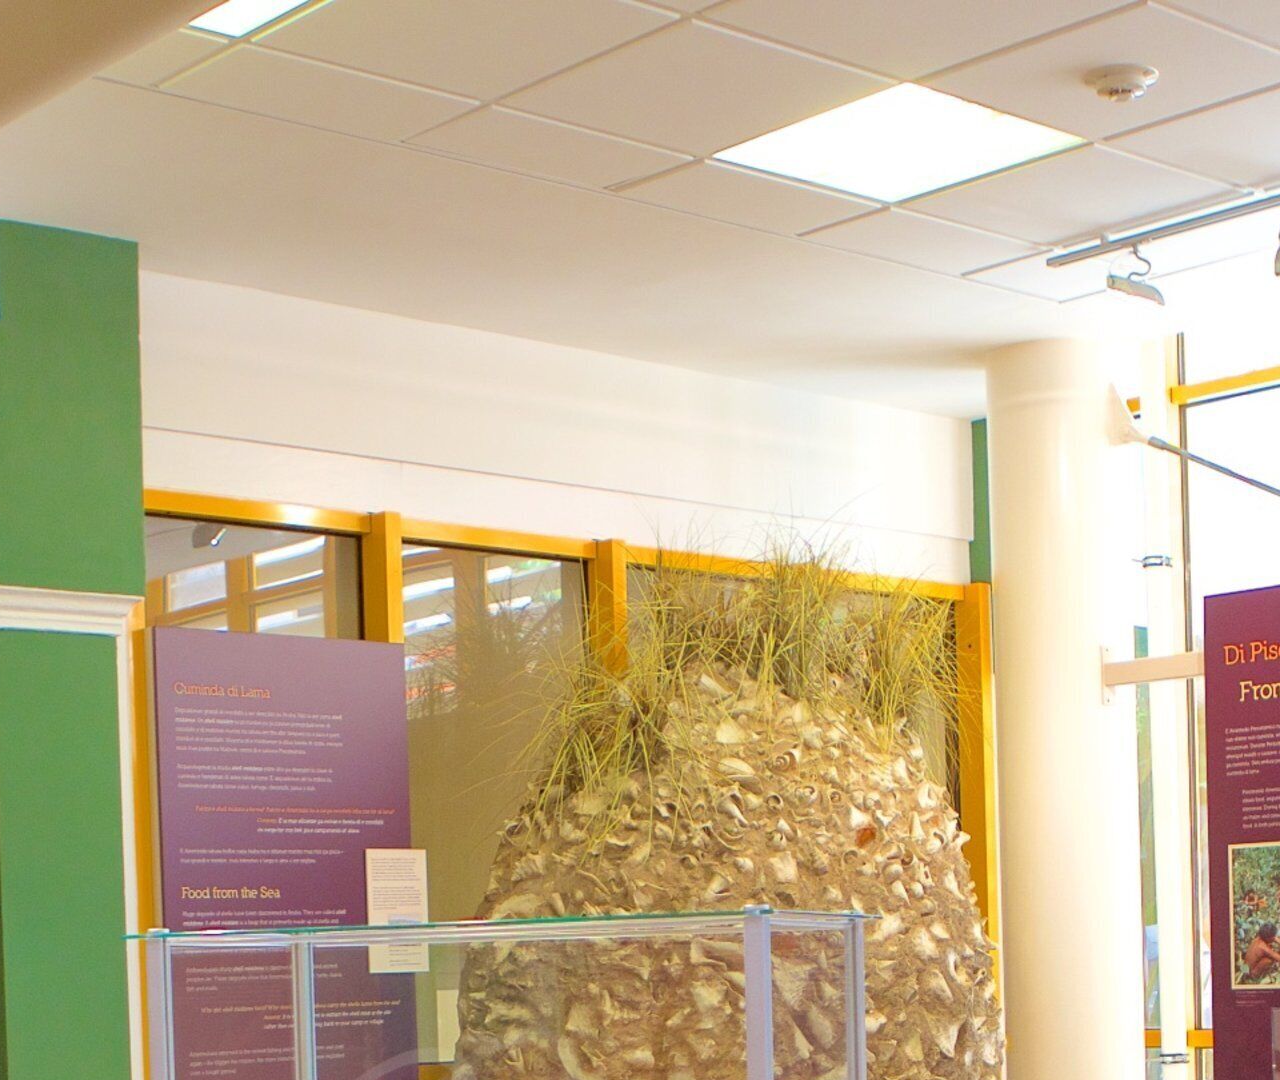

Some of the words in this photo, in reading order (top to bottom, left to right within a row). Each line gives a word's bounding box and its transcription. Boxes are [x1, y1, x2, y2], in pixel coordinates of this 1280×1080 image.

[1224, 643, 1245, 666] Di
[181, 886, 210, 899] Food
[212, 886, 238, 899] from
[240, 886, 258, 899] the
[260, 886, 281, 899] Sea
